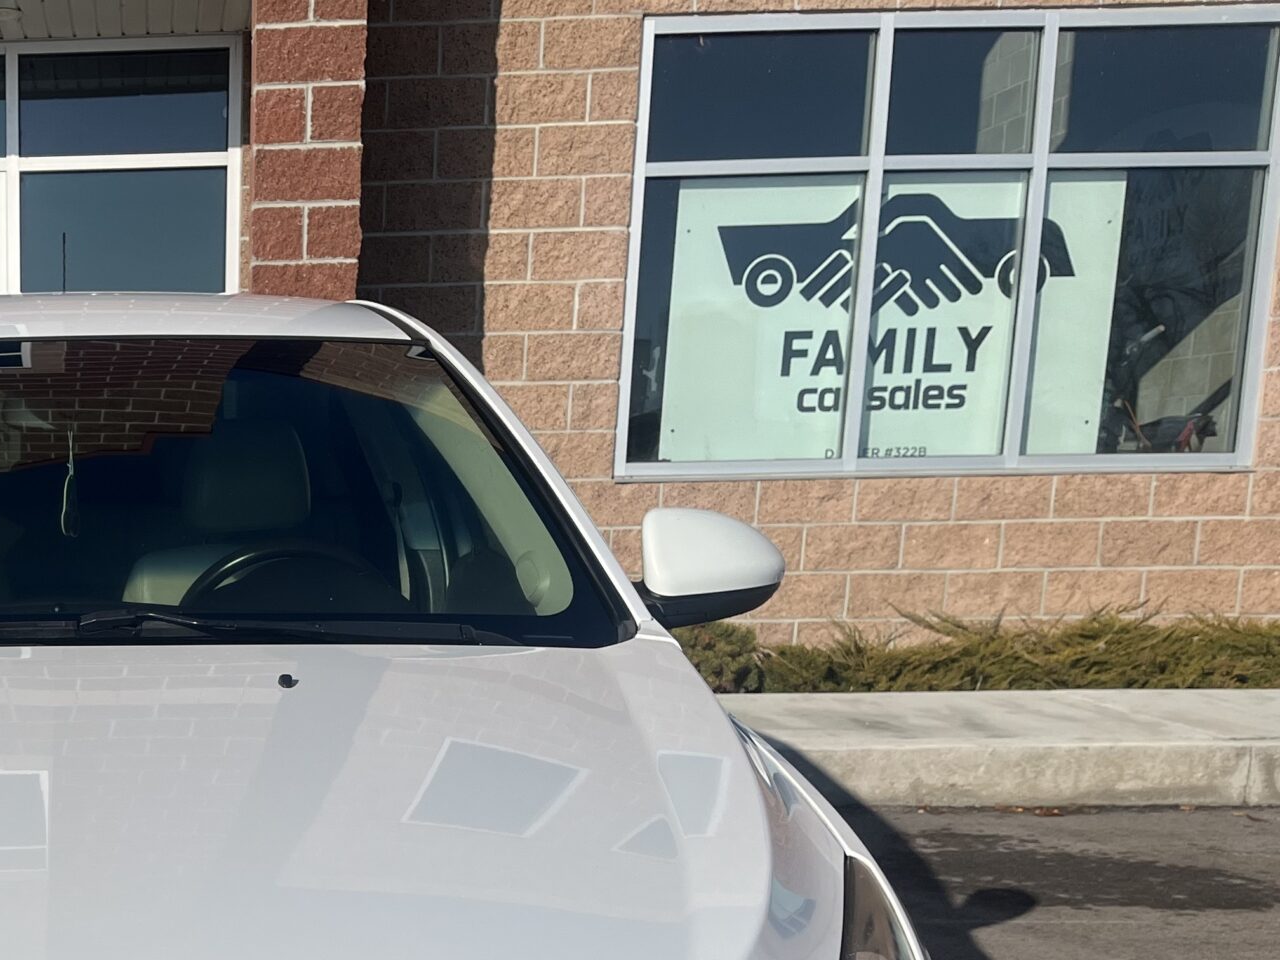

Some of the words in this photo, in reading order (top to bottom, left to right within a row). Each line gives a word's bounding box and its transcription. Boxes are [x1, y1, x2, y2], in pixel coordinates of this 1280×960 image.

[780, 325, 994, 377] FAMILY
[796, 386, 843, 413] ca
[865, 378, 968, 412] sales
[824, 447, 880, 460] DER
